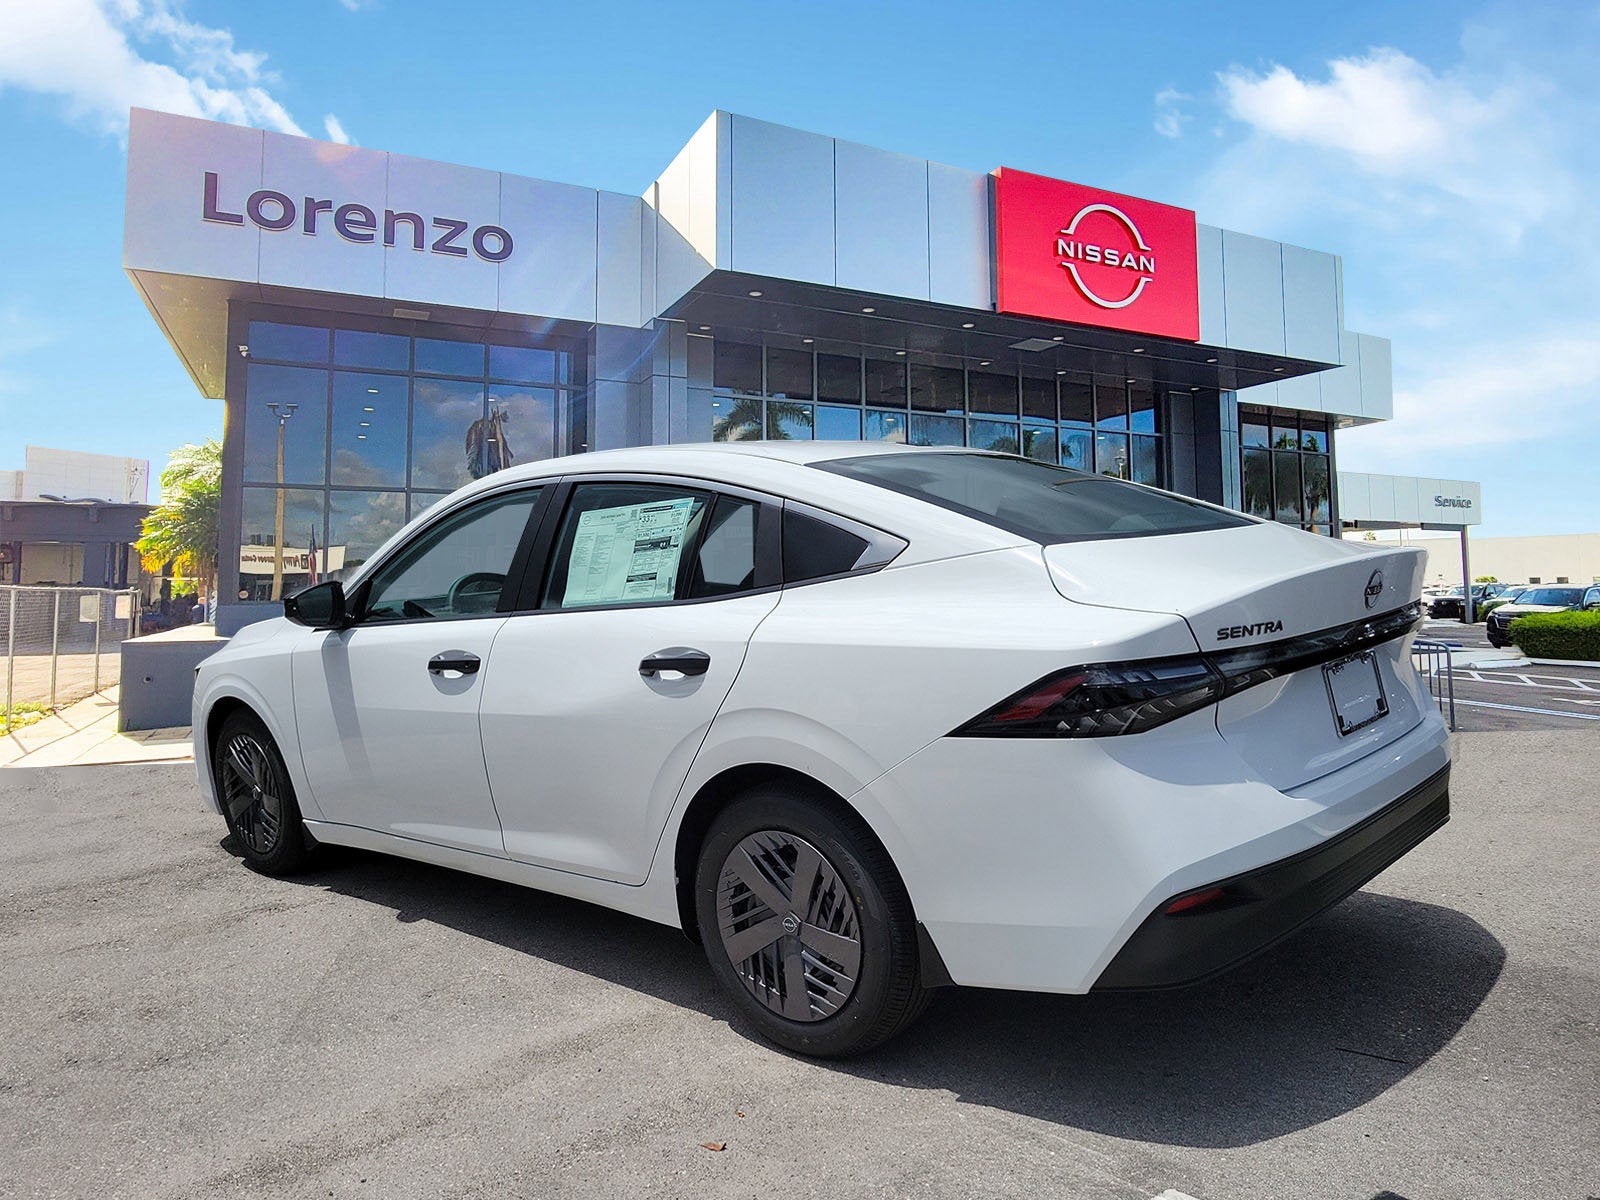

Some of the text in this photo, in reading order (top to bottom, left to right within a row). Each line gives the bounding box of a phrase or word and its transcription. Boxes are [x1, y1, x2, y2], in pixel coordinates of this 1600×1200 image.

[202, 171, 515, 262] Lorenzo
[1057, 238, 1155, 273] NISSAN
[1434, 495, 1472, 509] Service
[1217, 620, 1283, 641] SENTRA
